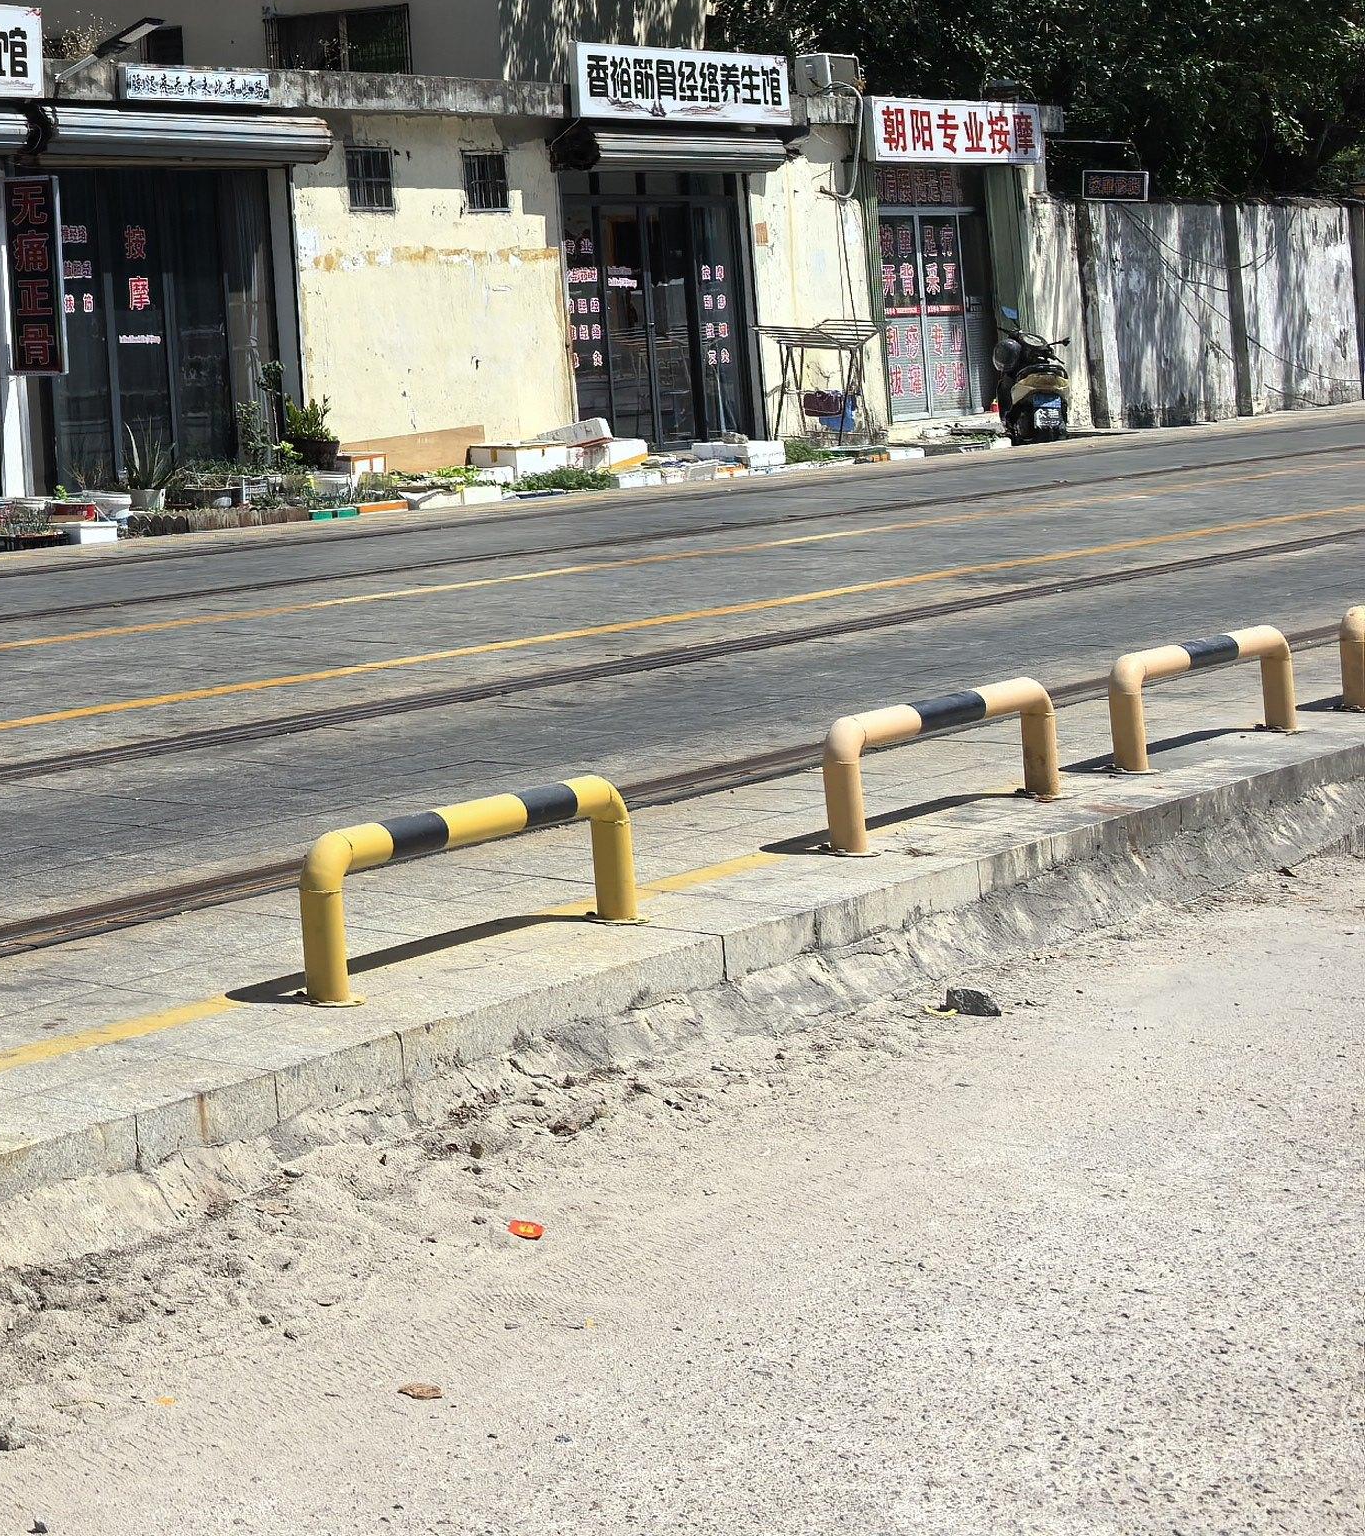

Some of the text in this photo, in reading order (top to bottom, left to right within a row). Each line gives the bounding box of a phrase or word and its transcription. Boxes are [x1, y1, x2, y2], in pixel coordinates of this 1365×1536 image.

[587, 54, 783, 106] 香裕筋骨经络养生馆
[881, 105, 1036, 155] 朝阳专业按摩
[12, 185, 54, 365] 无痛正骨
[125, 225, 151, 311] 按摩
